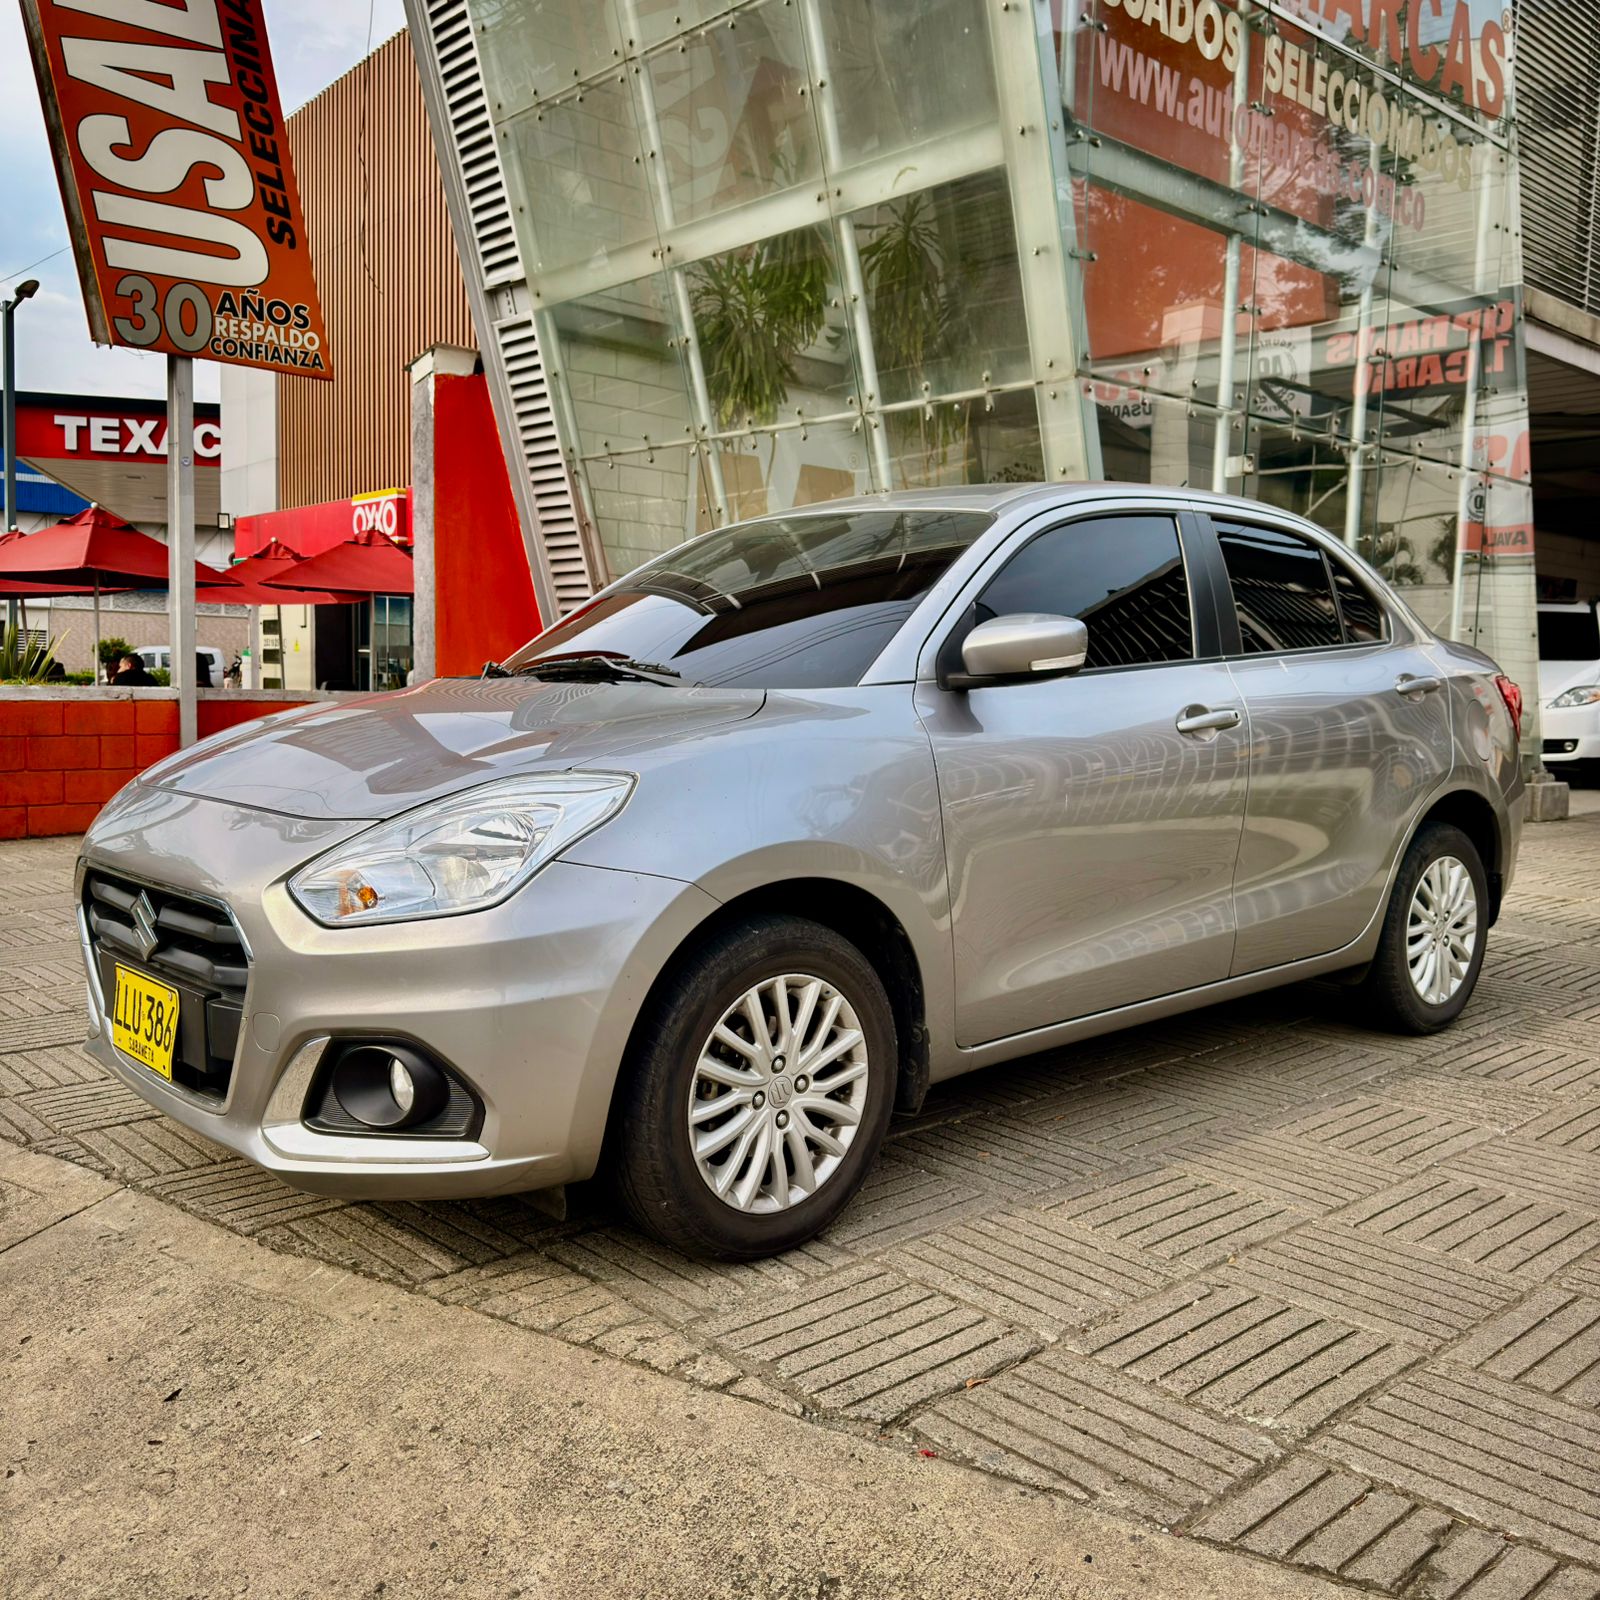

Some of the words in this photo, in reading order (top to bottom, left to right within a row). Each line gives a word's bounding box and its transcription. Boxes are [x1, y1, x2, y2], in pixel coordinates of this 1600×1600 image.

[1265, 35, 1472, 192] SELECCIONADOS
[113, 275, 213, 352] 30
[214, 289, 310, 330] AÑOS
[214, 316, 320, 351] RESPALDO
[210, 336, 324, 371] CONFIANZA
[352, 500, 397, 536] OXXO
[114, 979, 142, 1036] LLU
[144, 993, 175, 1053] 386
